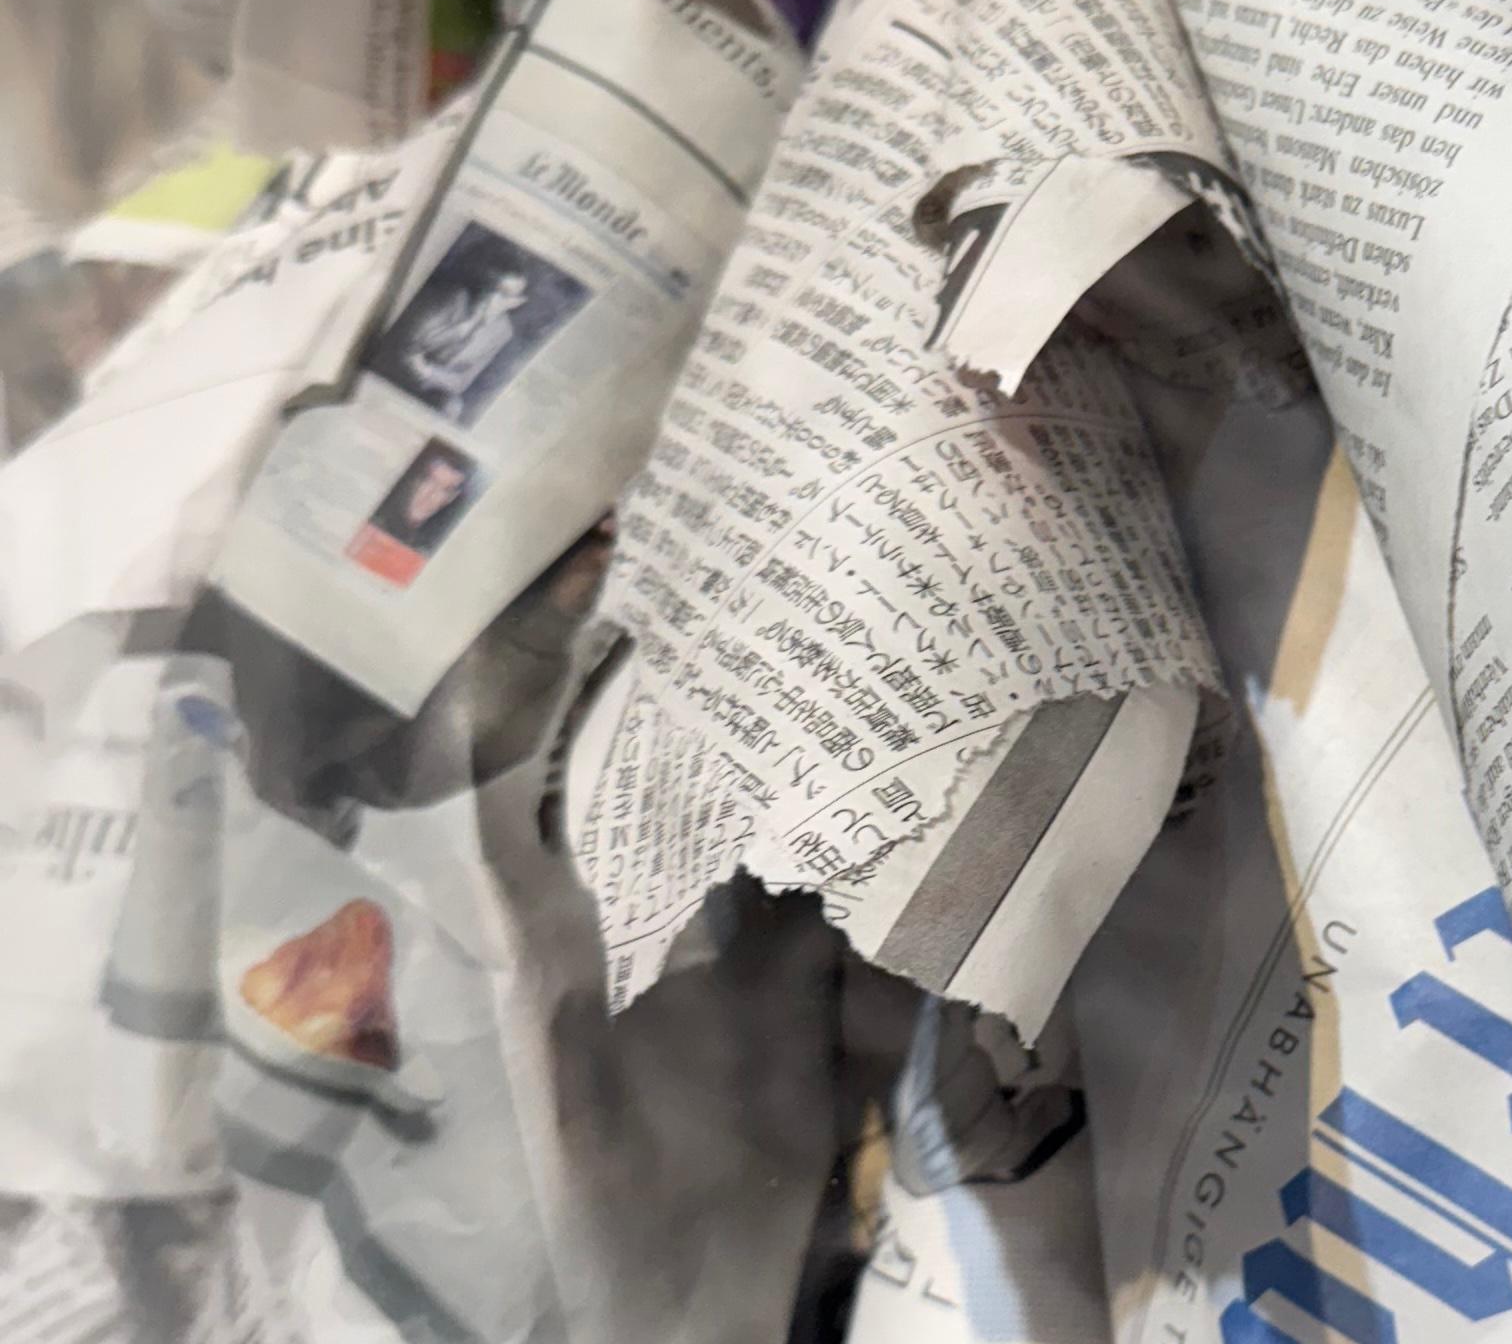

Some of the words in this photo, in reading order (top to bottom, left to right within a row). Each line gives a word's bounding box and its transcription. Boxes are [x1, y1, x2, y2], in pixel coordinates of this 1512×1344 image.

[1357, 2, 1384, 24] zu
[1461, 4, 1497, 34] des
[1387, 11, 1447, 49] Weise
[1353, 37, 1390, 68] das
[1311, 64, 1360, 99] Erbe
[1395, 49, 1463, 91] haben
[1368, 80, 1428, 111] unser
[1466, 74, 1504, 99] wir
[1433, 101, 1483, 129] und
[1379, 123, 1416, 155] das
[1420, 134, 1461, 168] hen
[1349, 155, 1443, 204] zösischen
[1339, 193, 1363, 215] zu
[1365, 200, 1425, 241] Luxus
[1169, 913, 1359, 1302] UNABHÄNGIGE
